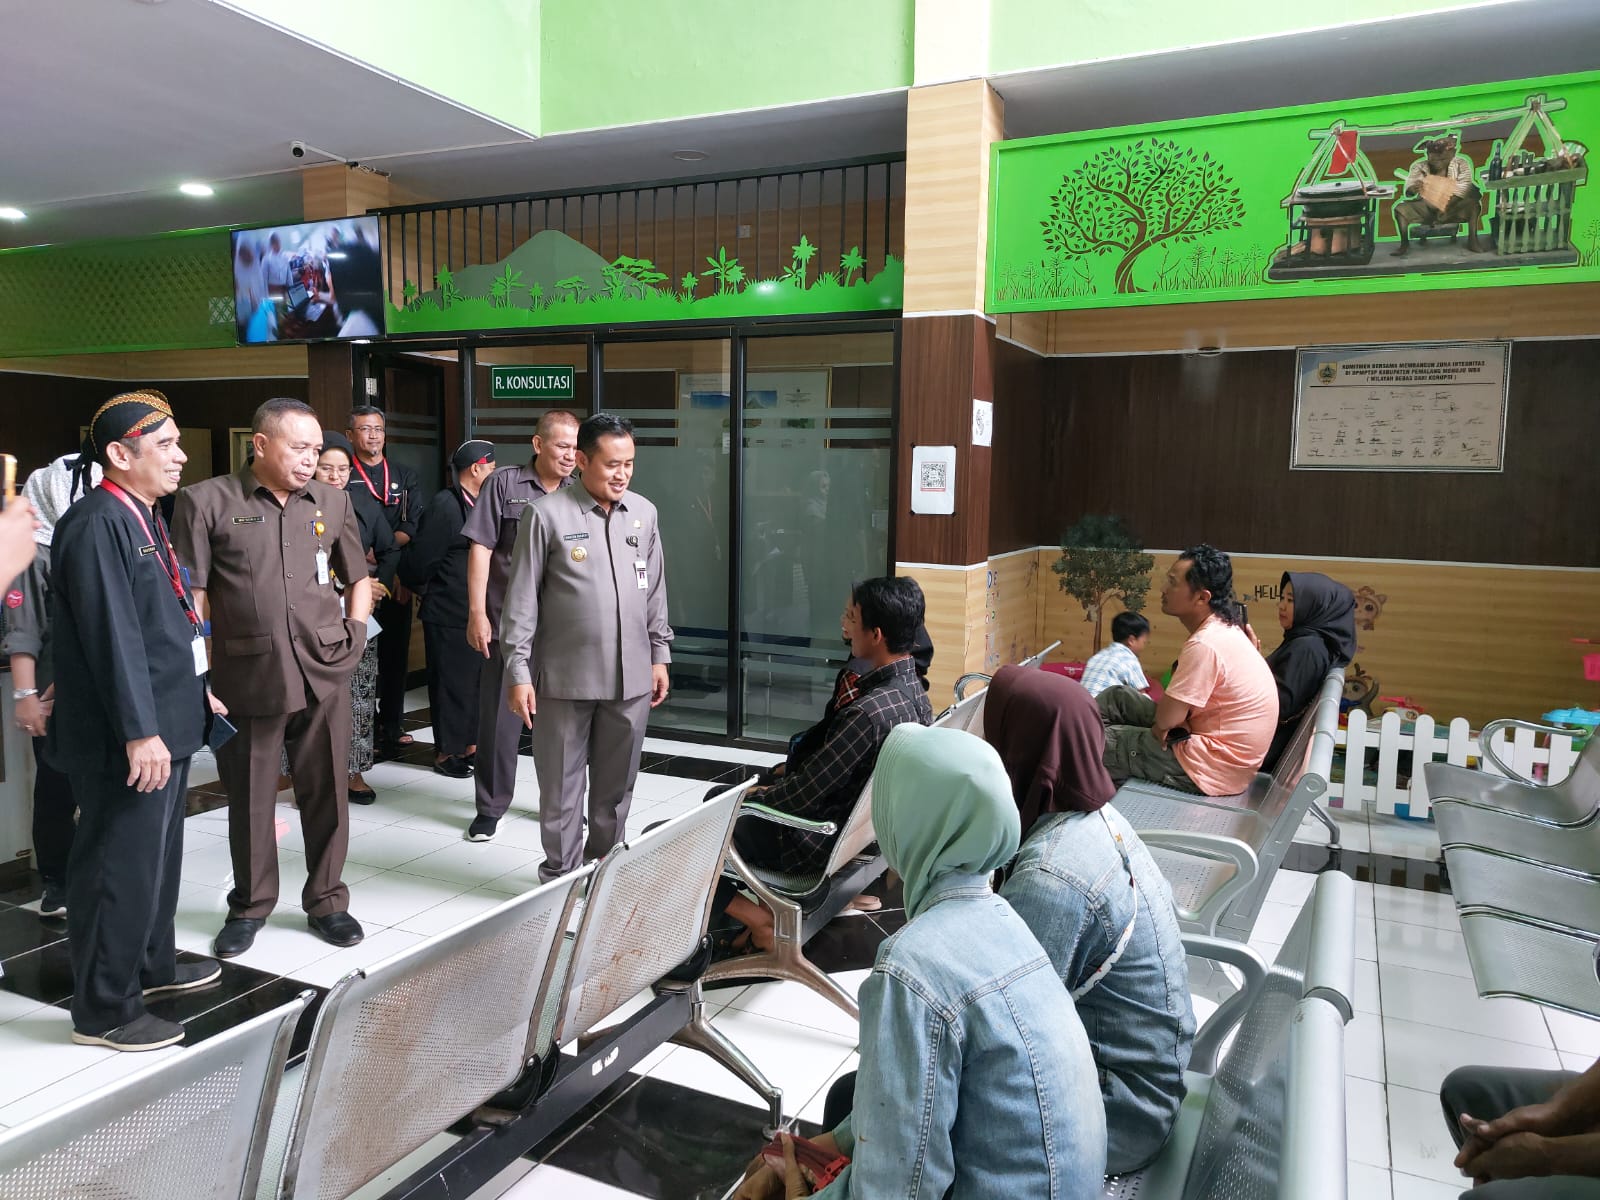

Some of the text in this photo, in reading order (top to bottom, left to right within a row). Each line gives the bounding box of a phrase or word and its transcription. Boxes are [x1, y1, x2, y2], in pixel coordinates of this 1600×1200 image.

[495, 375, 570, 390] R. KONSULTASI
[1254, 584, 1281, 600] HELL
